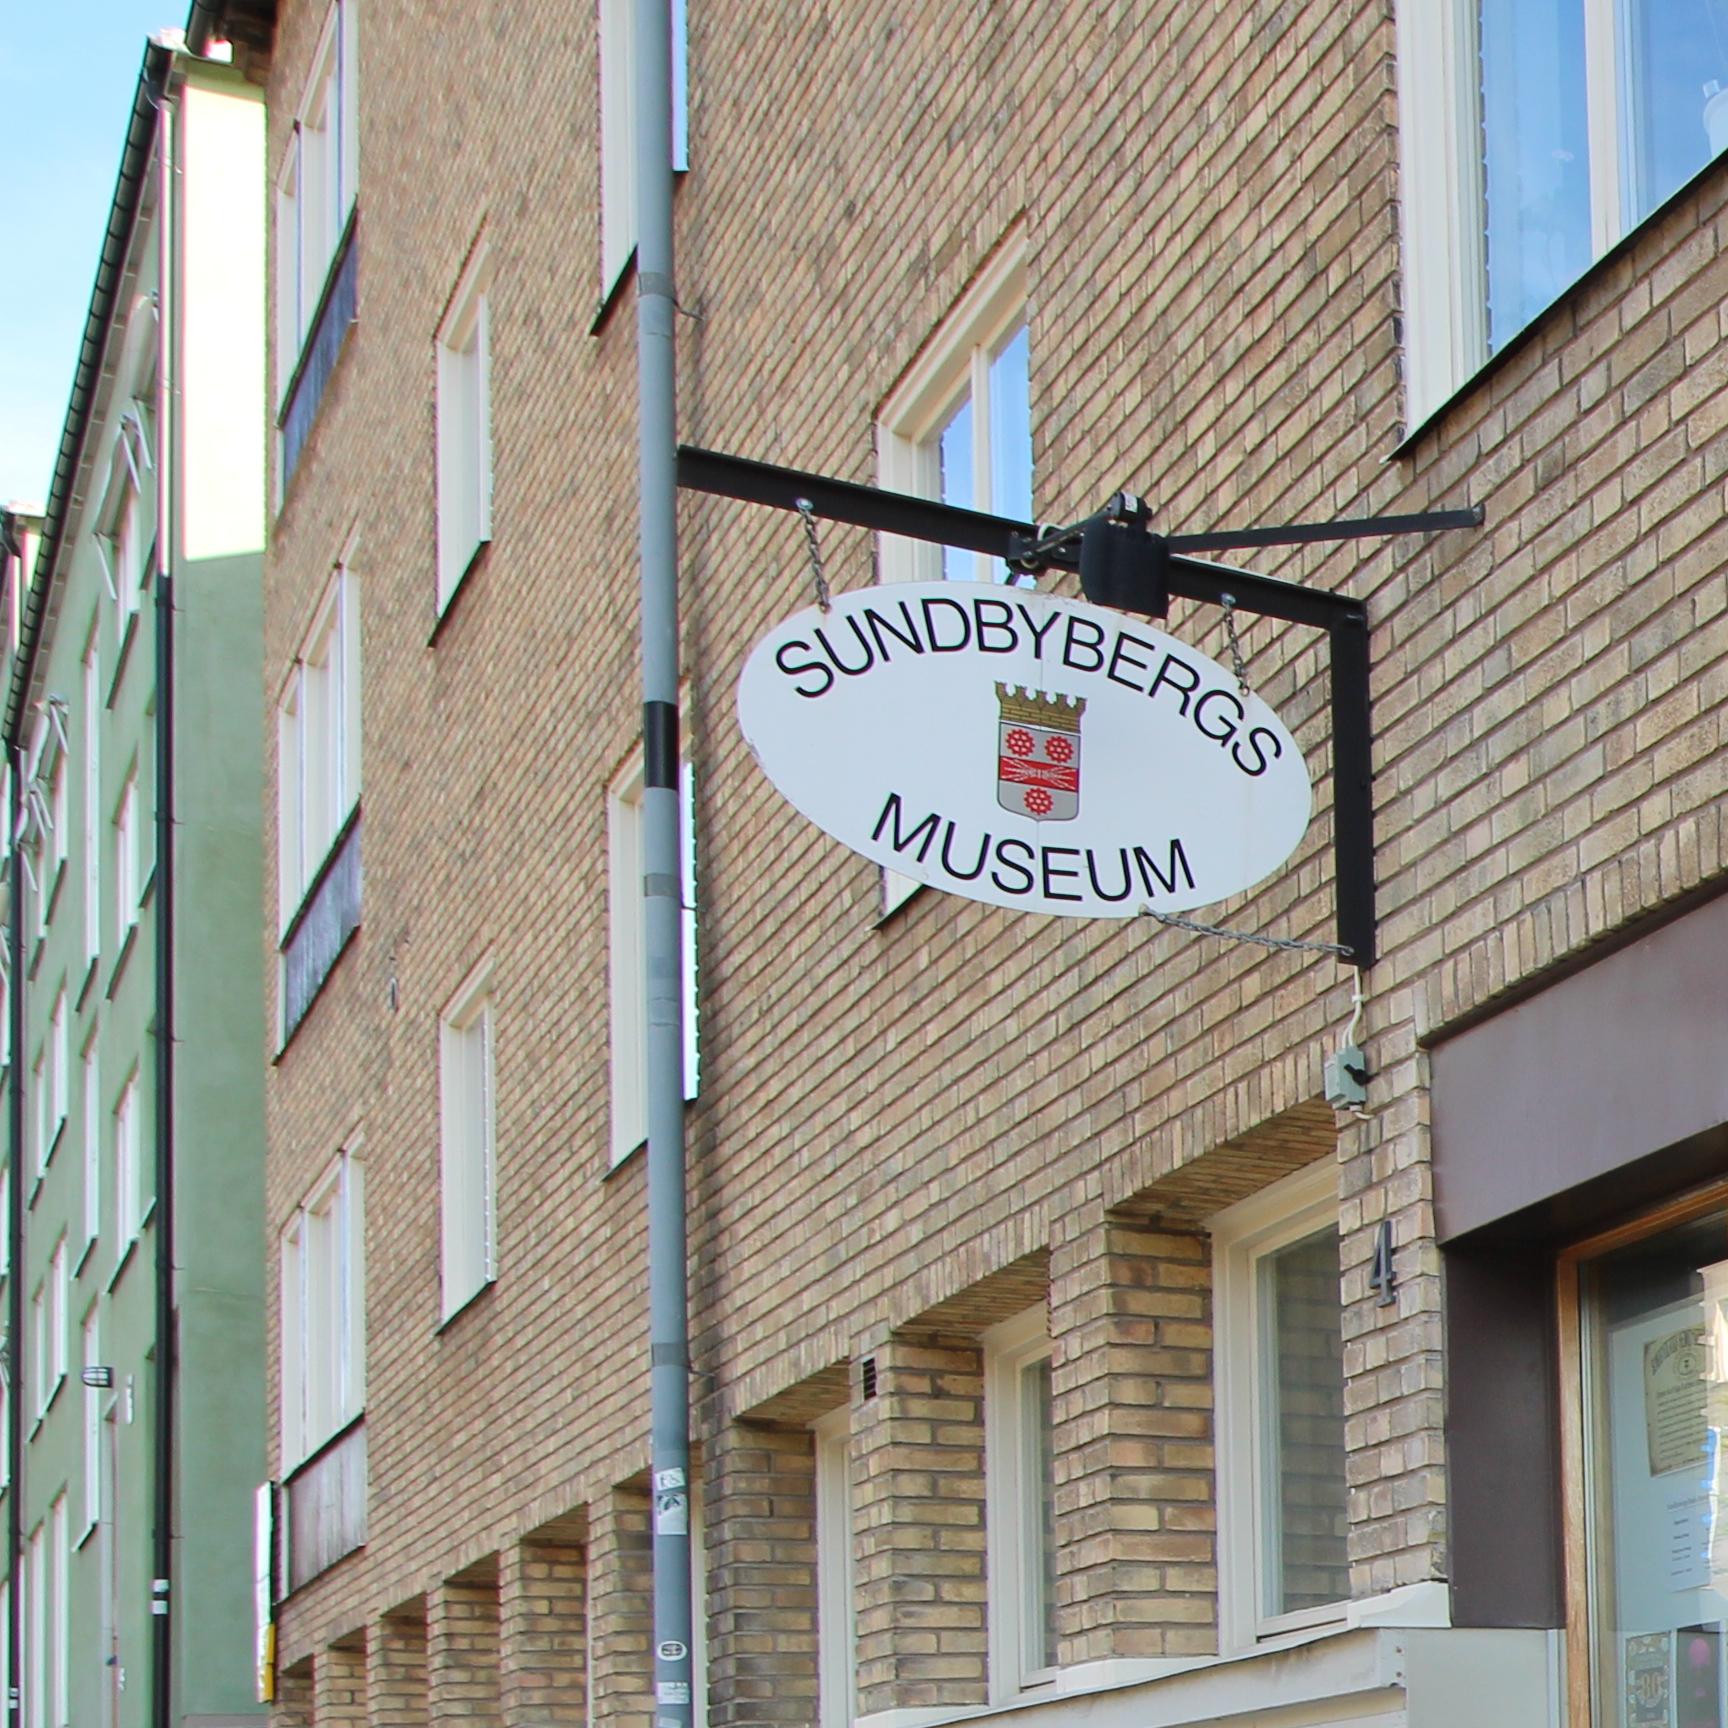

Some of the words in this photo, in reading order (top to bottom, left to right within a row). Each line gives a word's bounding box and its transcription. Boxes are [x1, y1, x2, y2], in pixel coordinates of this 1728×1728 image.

[775, 598, 1282, 777] SUNDBYBERGS
[871, 793, 1196, 902] MUSEUM
[1369, 1220, 1398, 1309] 4
